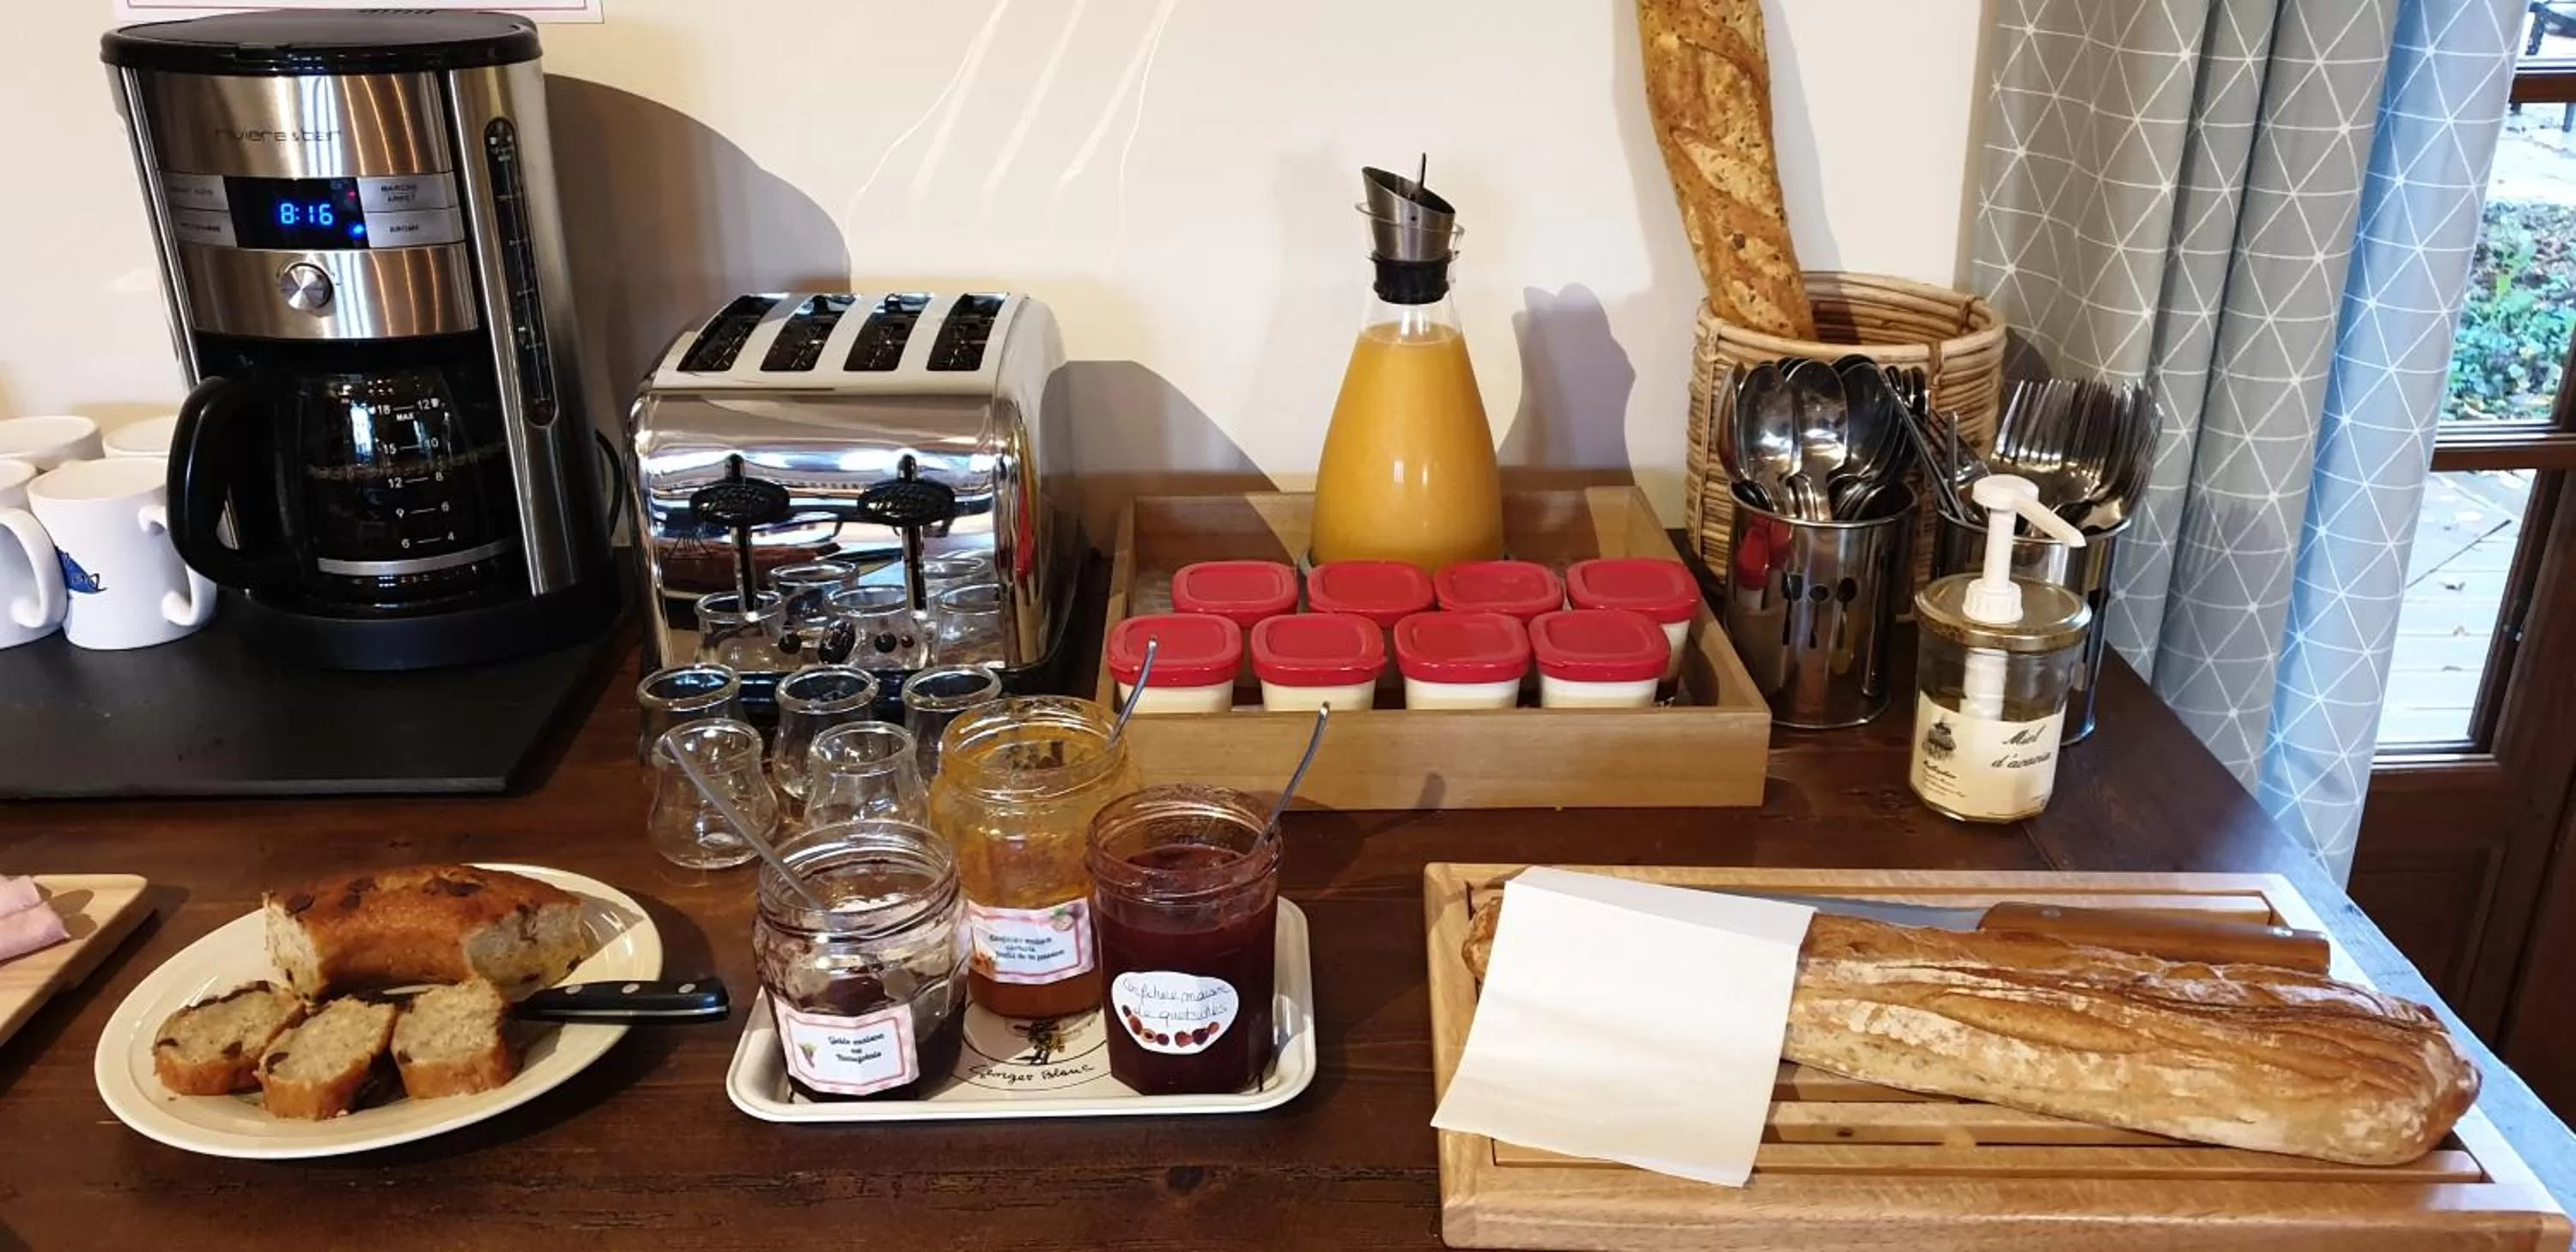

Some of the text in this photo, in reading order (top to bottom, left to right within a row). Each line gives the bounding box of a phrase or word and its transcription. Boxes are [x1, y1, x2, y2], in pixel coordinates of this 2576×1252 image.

[280, 202, 334, 226] 8:16
[417, 398, 431, 410] 12
[395, 411, 415, 422] MAX
[387, 477, 404, 489] 12
[2002, 724, 2048, 746] Miel
